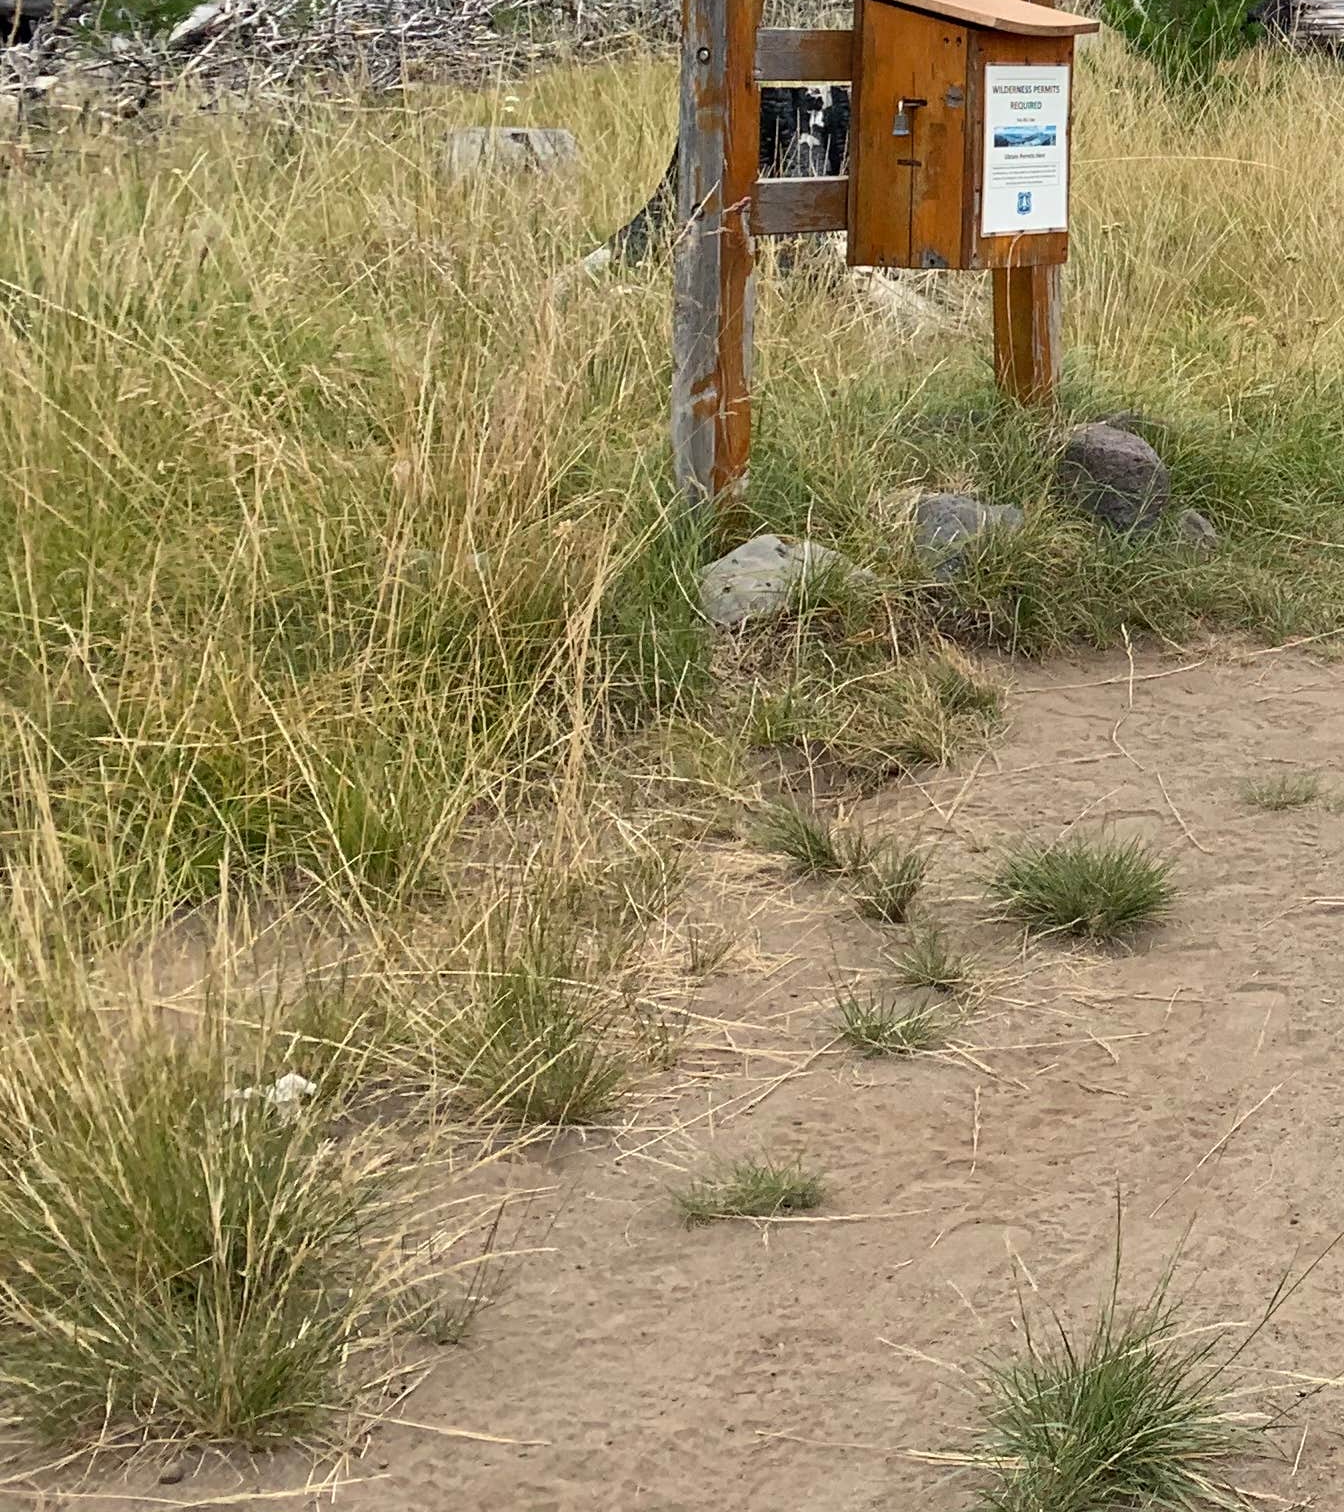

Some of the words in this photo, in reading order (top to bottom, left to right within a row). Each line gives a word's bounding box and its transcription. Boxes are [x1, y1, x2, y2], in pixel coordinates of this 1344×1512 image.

[992, 85, 1032, 94] WILDERNESS
[1033, 85, 1061, 94] PERMITS
[1010, 101, 1042, 110] REQUIRED
